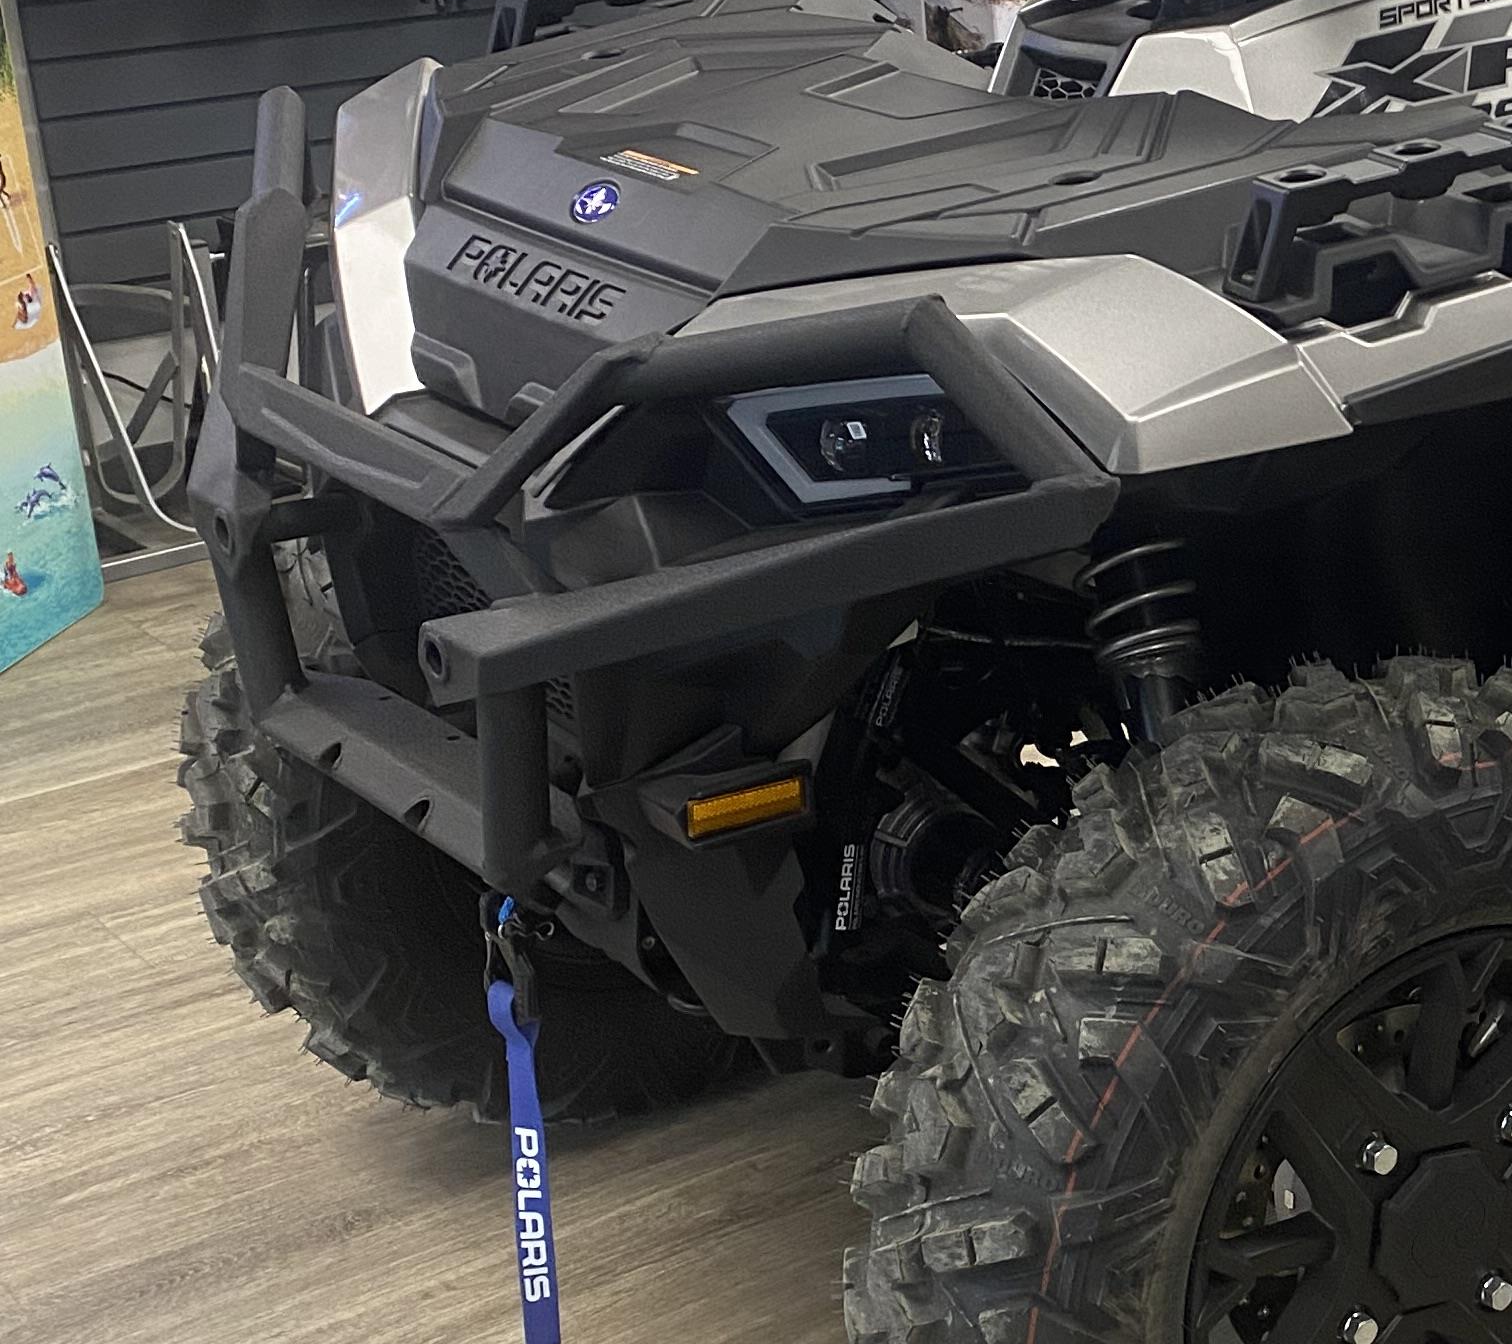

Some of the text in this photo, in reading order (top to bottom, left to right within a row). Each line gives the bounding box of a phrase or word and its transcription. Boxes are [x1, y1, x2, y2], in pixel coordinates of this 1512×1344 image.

[447, 234, 627, 323] POLARIS
[835, 844, 855, 931] POLARIS
[513, 1125, 552, 1303] POLARIS
